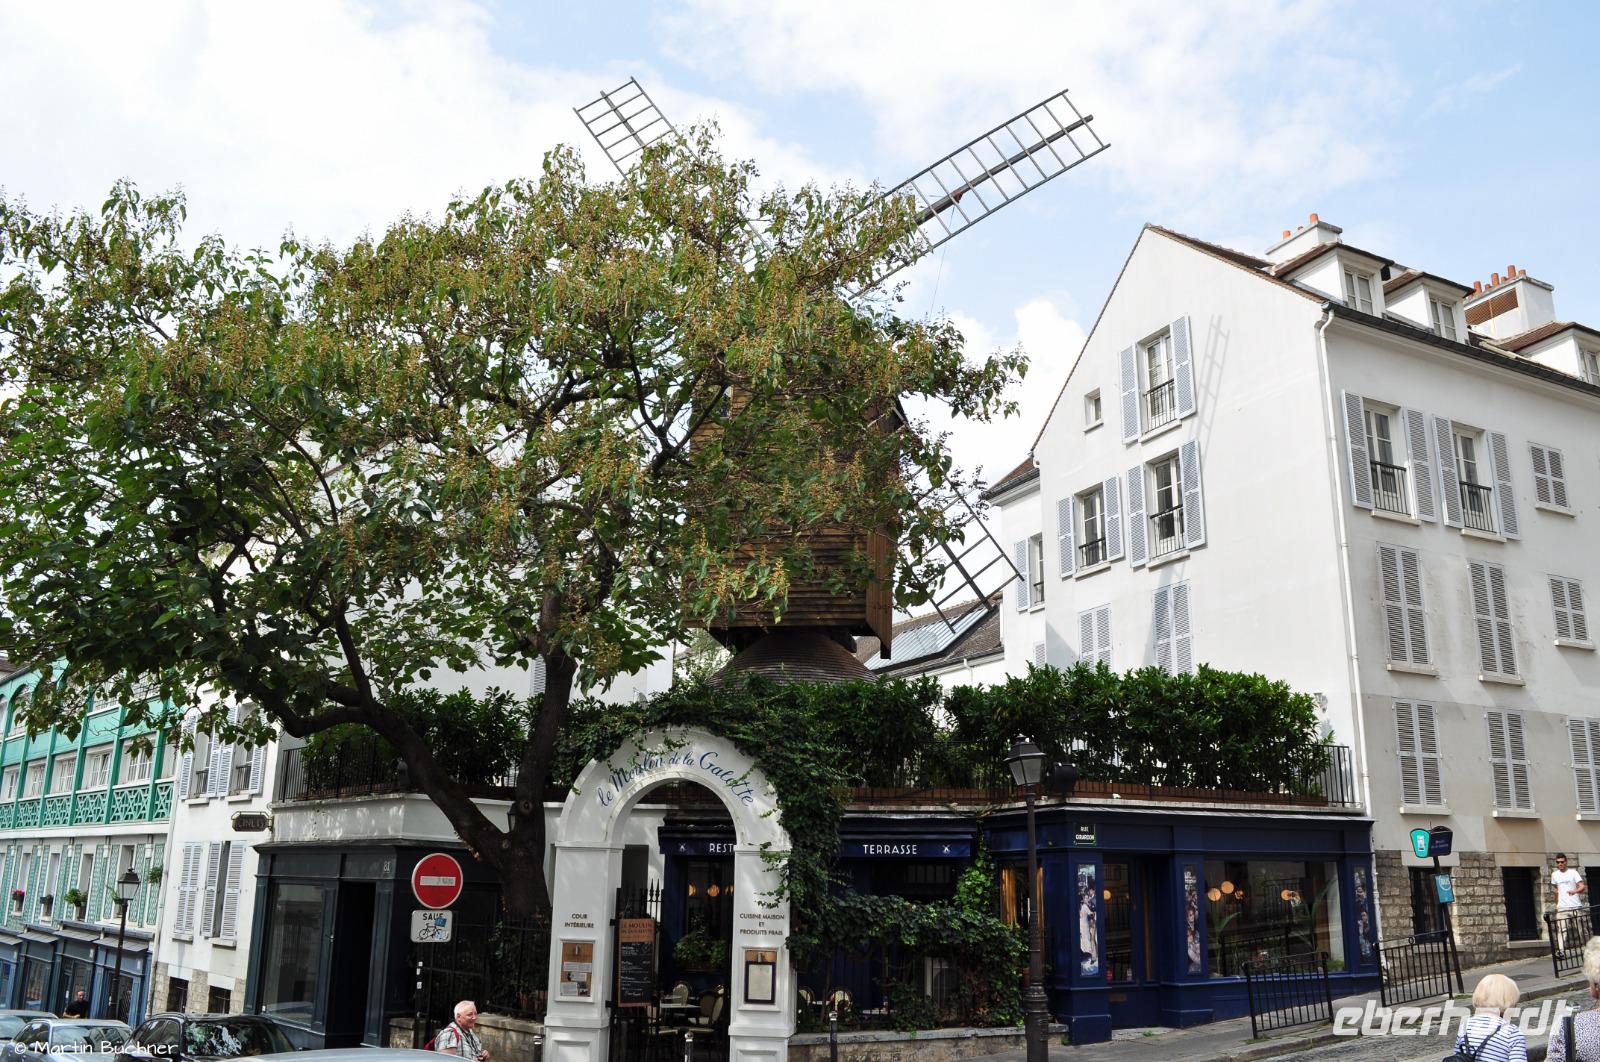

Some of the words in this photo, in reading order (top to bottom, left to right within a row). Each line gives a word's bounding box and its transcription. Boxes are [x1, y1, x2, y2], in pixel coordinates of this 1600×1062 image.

[668, 752, 681, 765] de
[682, 751, 695, 765] la
[862, 844, 918, 855] TERRASSE
